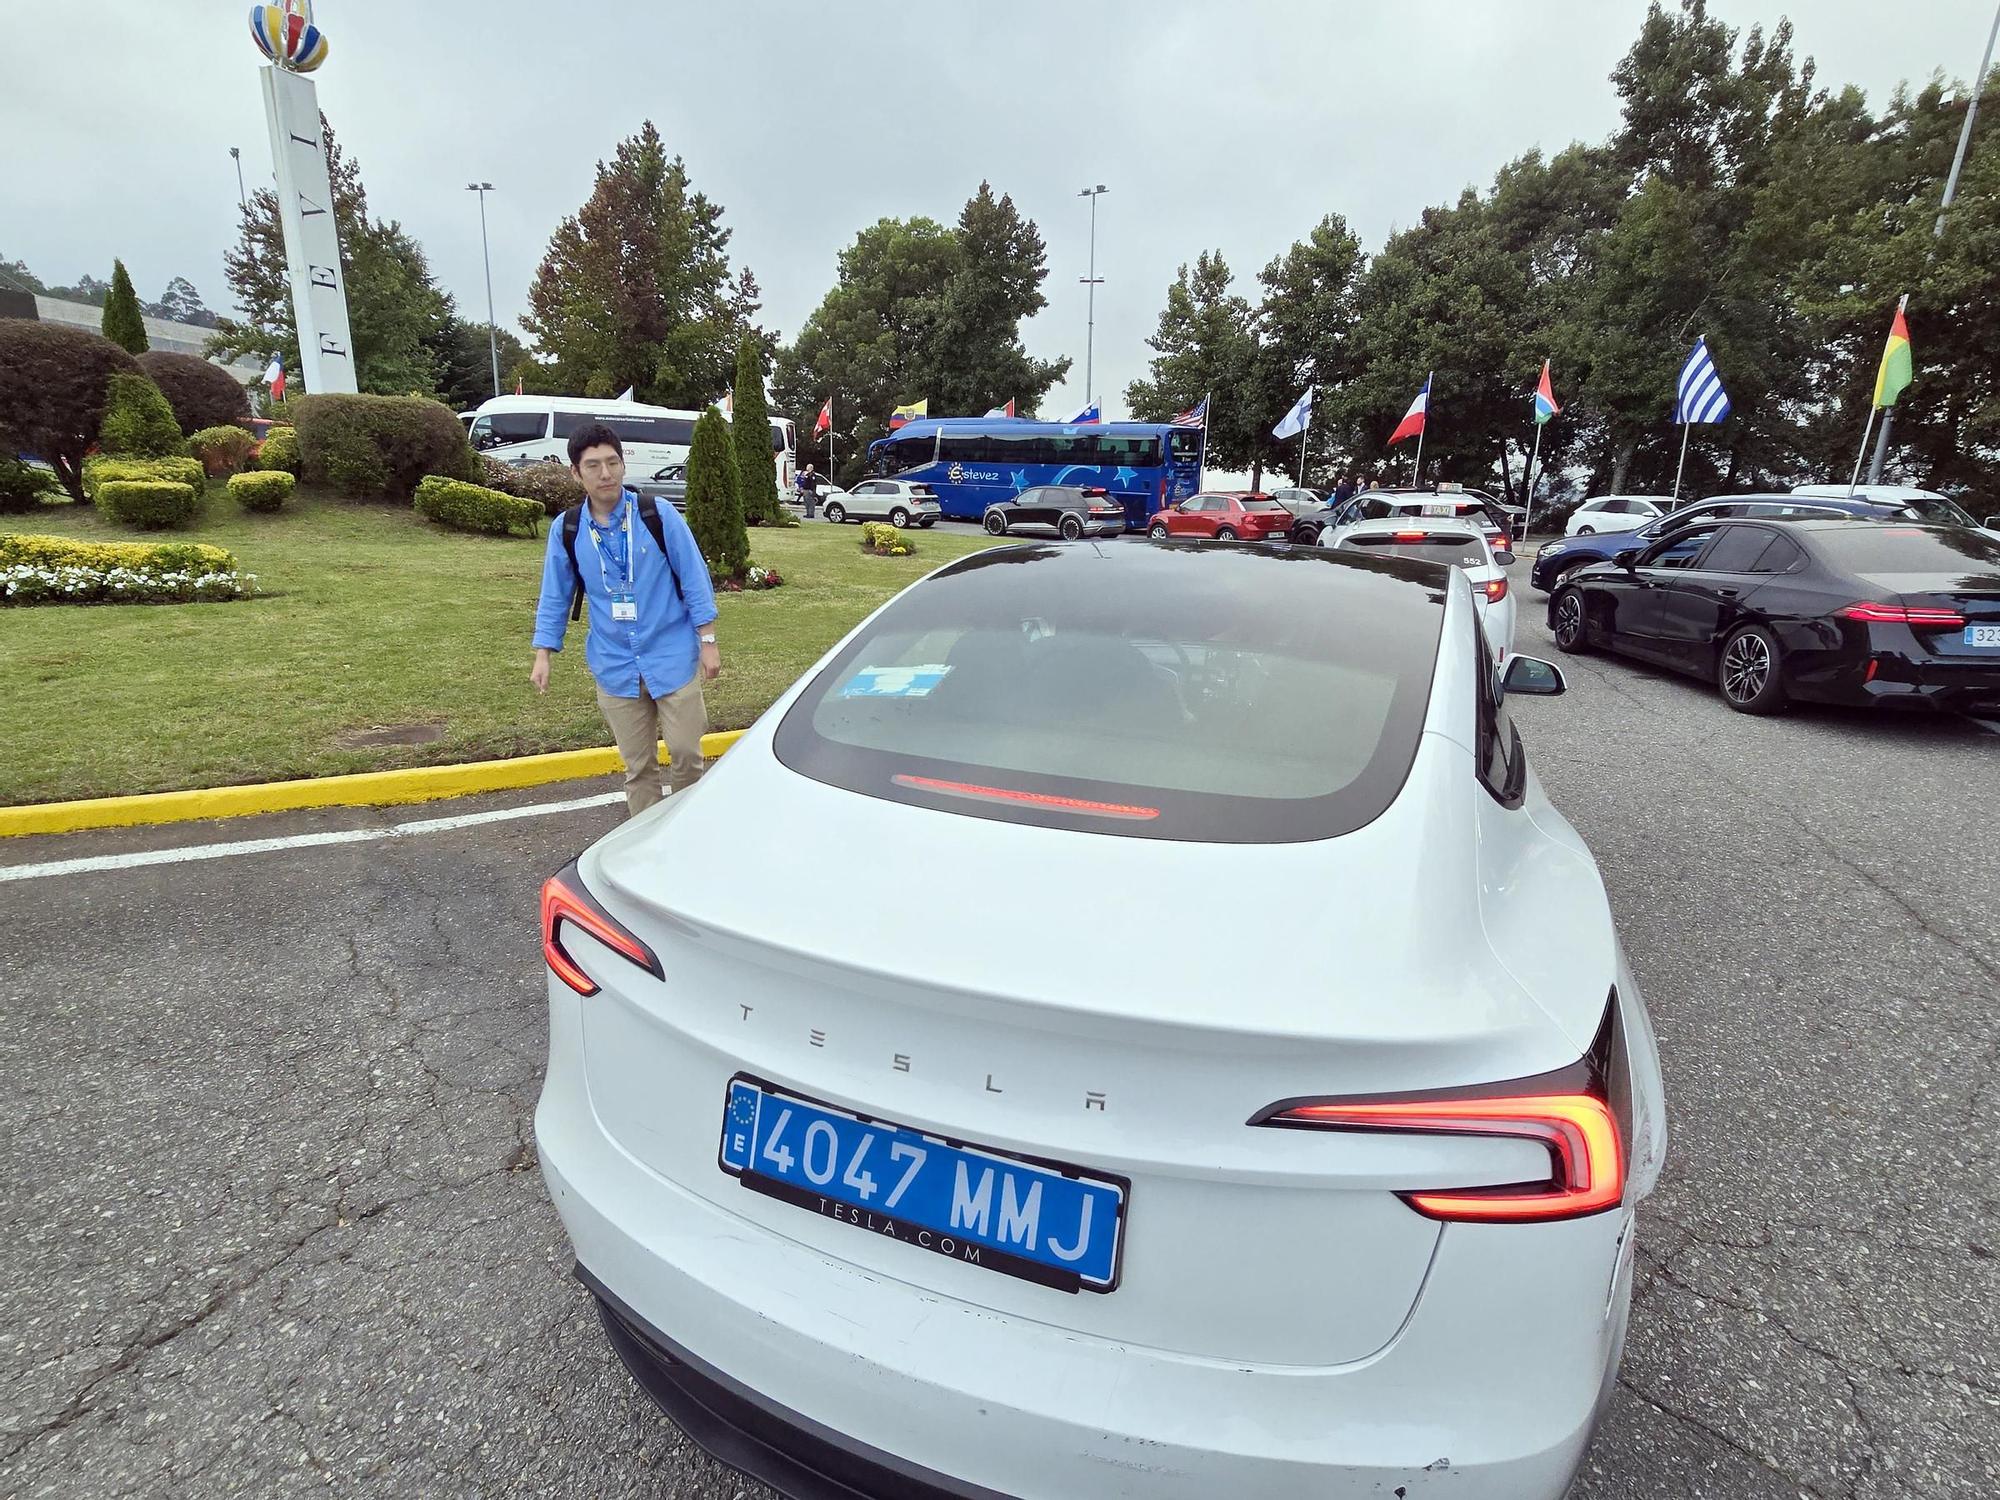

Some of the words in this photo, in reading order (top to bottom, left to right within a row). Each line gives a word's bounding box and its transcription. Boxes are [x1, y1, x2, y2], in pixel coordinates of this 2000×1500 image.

[950, 466, 999, 480] Estevez
[1433, 505, 1449, 514] TAXI
[1463, 557, 1481, 565] 552
[740, 1003, 1107, 1111] TESLA
[733, 1133, 746, 1153] E
[763, 1108, 927, 1209] 4047
[950, 1160, 1095, 1262] MMJ
[819, 1198, 981, 1263] TESLA.COM
